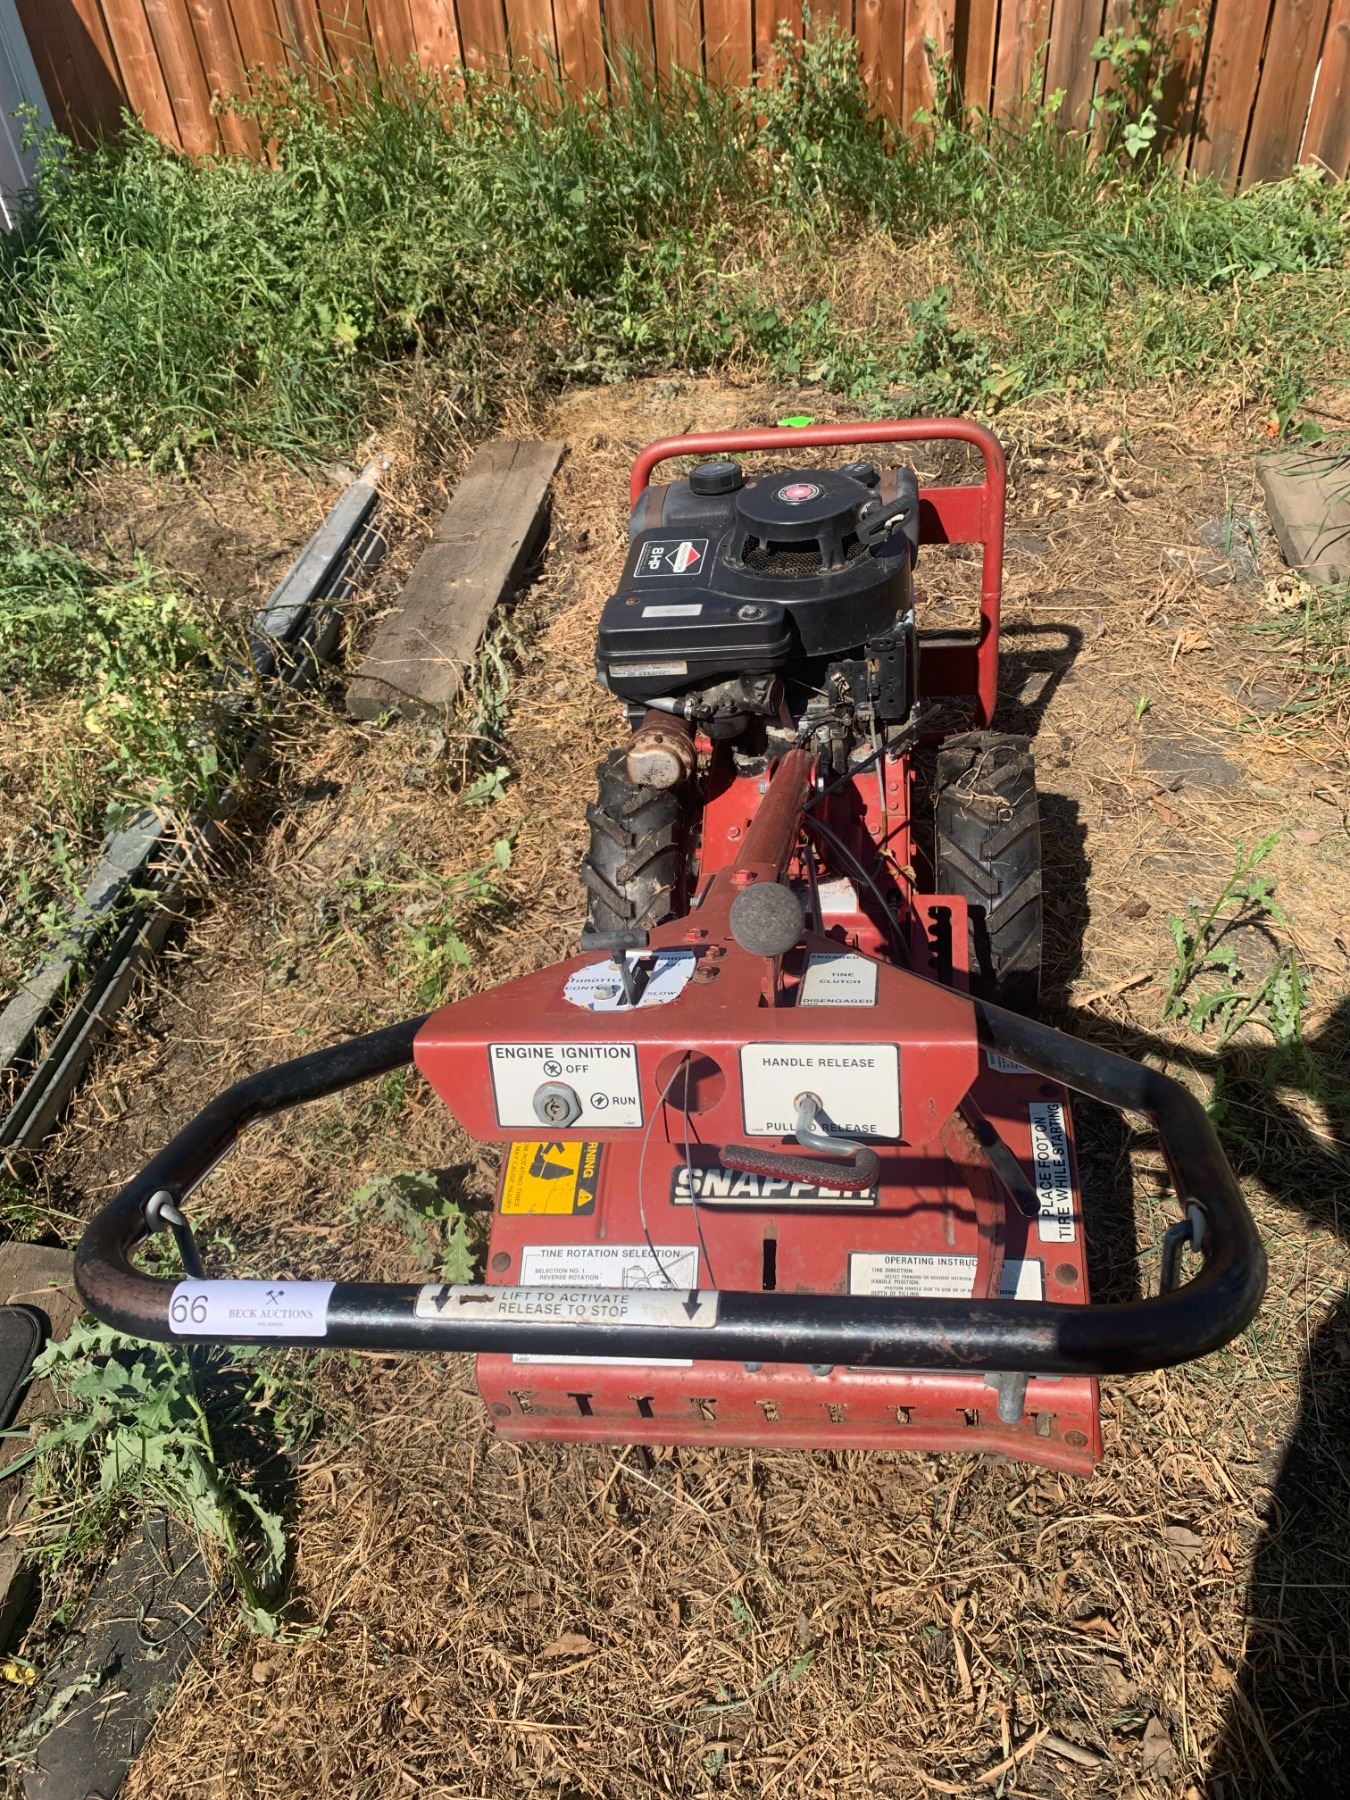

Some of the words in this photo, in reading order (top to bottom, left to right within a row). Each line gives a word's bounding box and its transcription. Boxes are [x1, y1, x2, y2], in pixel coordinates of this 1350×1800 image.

[495, 1047, 554, 1059] ENGINE
[561, 1047, 632, 1059] IGNITION
[566, 1064, 590, 1073] OFF
[762, 1058, 814, 1067] HANDLE
[818, 1058, 876, 1068] RELEASE
[612, 1097, 636, 1105] RUN
[766, 1122, 796, 1131] PULL
[822, 1124, 877, 1133] RELEASE
[1034, 1117, 1047, 1132] ON
[1048, 1104, 1064, 1156] STARTING
[513, 1146, 521, 1160] MAY
[583, 1142, 599, 1178] RNING
[1036, 1136, 1050, 1170] FOOT
[509, 1162, 518, 1184] CAUSE
[517, 1154, 527, 1186] ROTATING
[1053, 1158, 1069, 1202] WHILE
[513, 1188, 522, 1208] TINES
[1039, 1172, 1054, 1216] PLACE
[1058, 1206, 1071, 1238] TIRE
[541, 1249, 563, 1258] TINE
[567, 1249, 619, 1258] ROTATION
[622, 1250, 680, 1258] SELECTION
[884, 1256, 934, 1265] OPERATING
[937, 1258, 978, 1267] INSTRUC
[502, 1292, 530, 1300] LIFT
[537, 1292, 555, 1301] TO
[560, 1292, 630, 1303] ACTIVATE
[172, 1295, 208, 1324] 66
[228, 1308, 257, 1318] BECK
[259, 1309, 314, 1320] AUCTIONS
[498, 1302, 561, 1315] RELEASE
[568, 1305, 586, 1316] TO
[591, 1305, 629, 1317] STOP
